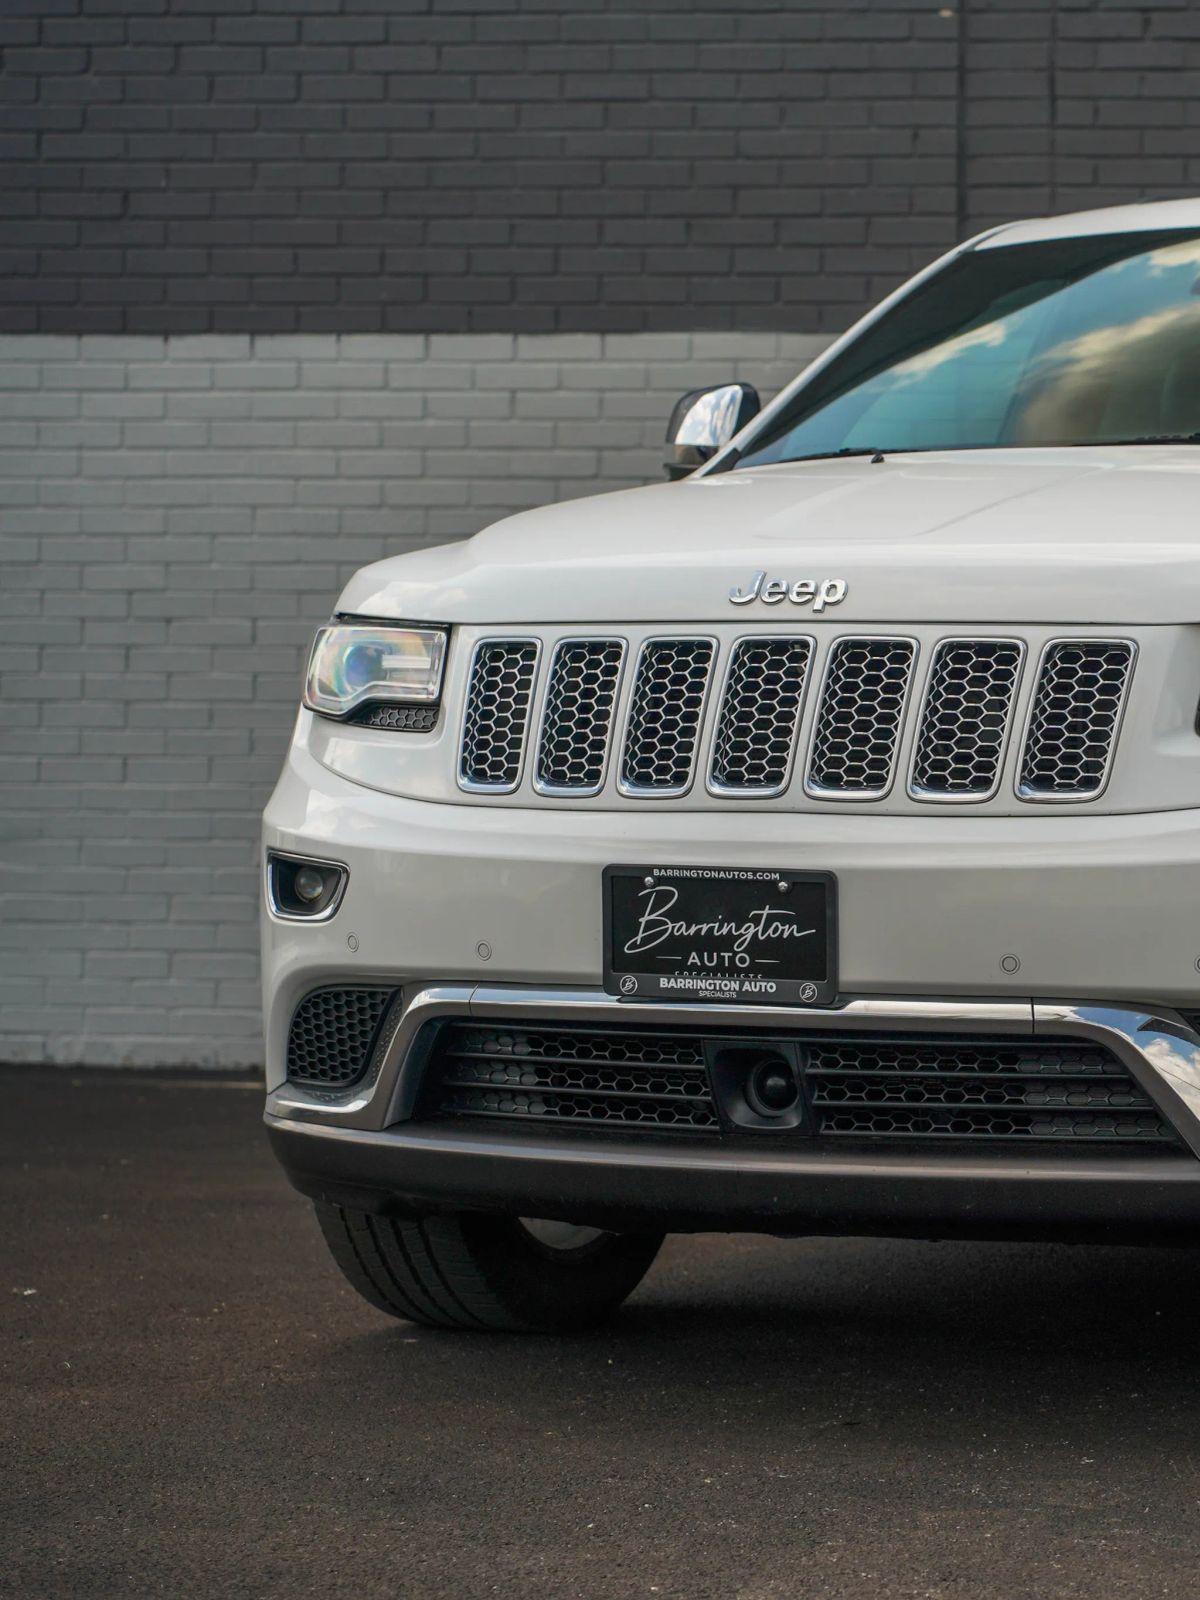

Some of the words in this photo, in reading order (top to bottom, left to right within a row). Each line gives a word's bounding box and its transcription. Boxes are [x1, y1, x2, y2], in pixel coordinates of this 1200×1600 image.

[728, 570, 848, 613] Jeep
[653, 868, 780, 880] BARRINGTONAUTOS.COM
[624, 886, 816, 954] Barrington
[687, 952, 750, 968] AUTO
[659, 977, 740, 992] BARRINGTON
[742, 981, 777, 993] AUTO
[698, 990, 737, 999] SPECIALISTS
